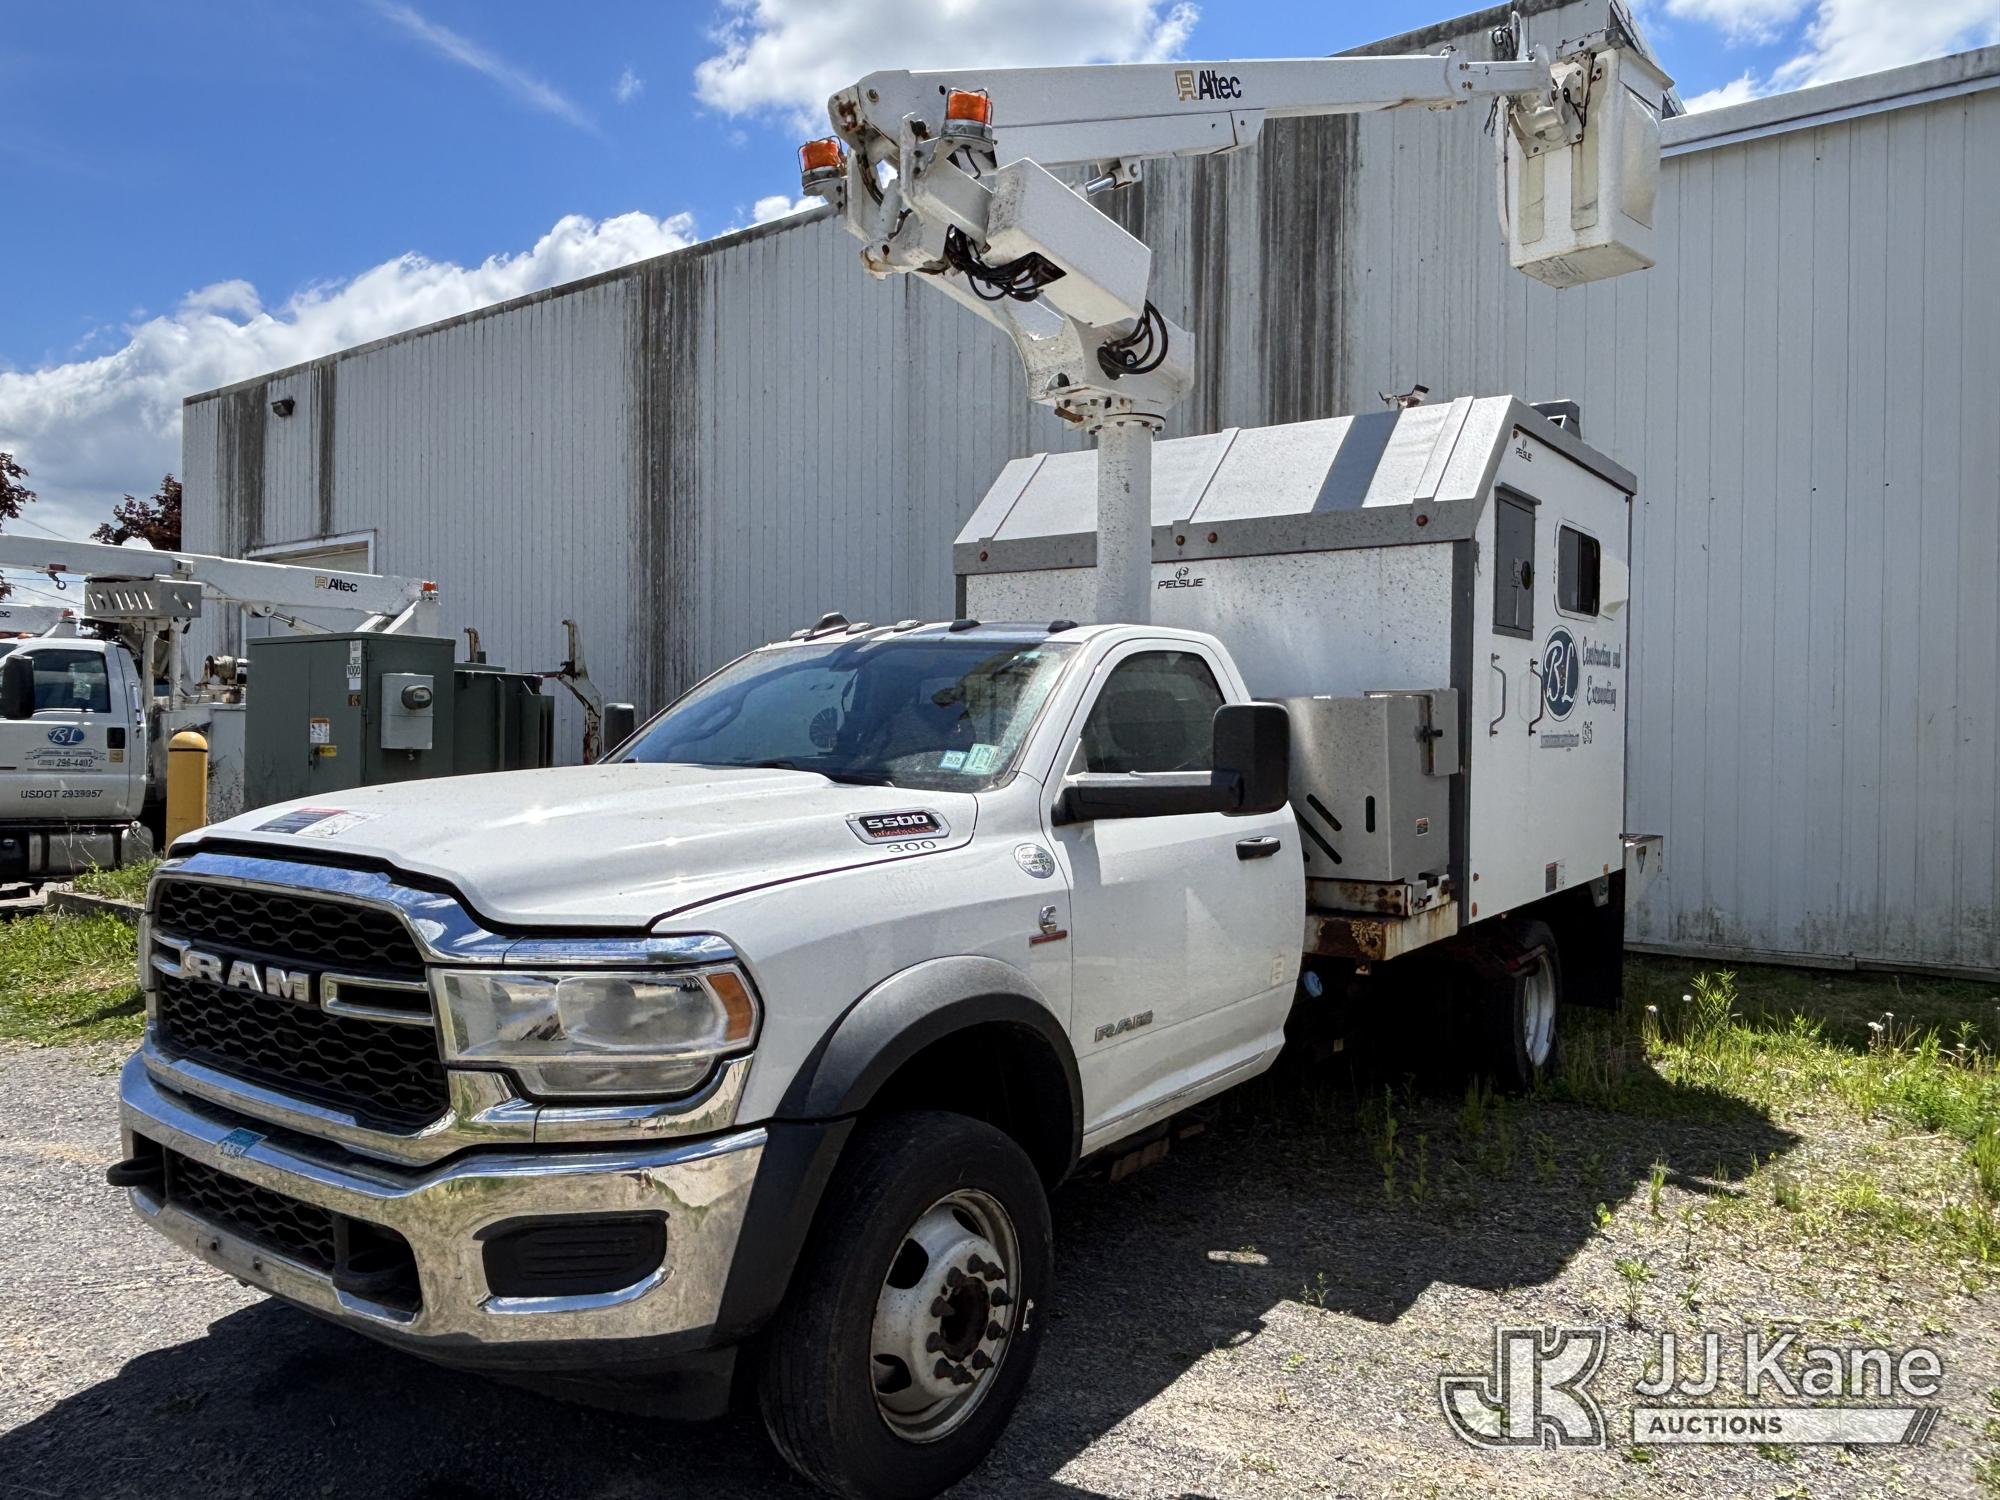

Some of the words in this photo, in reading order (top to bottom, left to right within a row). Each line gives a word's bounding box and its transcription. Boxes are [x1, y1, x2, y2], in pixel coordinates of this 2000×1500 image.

[1199, 70, 1241, 100] Altec
[328, 578, 358, 593] Altec
[1158, 578, 1206, 589] PELSUE
[48, 727, 81, 743] BL
[20, 790, 60, 799] USDOT
[866, 814, 929, 829] 5500
[886, 840, 937, 853] 300
[184, 950, 310, 1003] RAM
[1094, 1009, 1153, 1043] RAM
